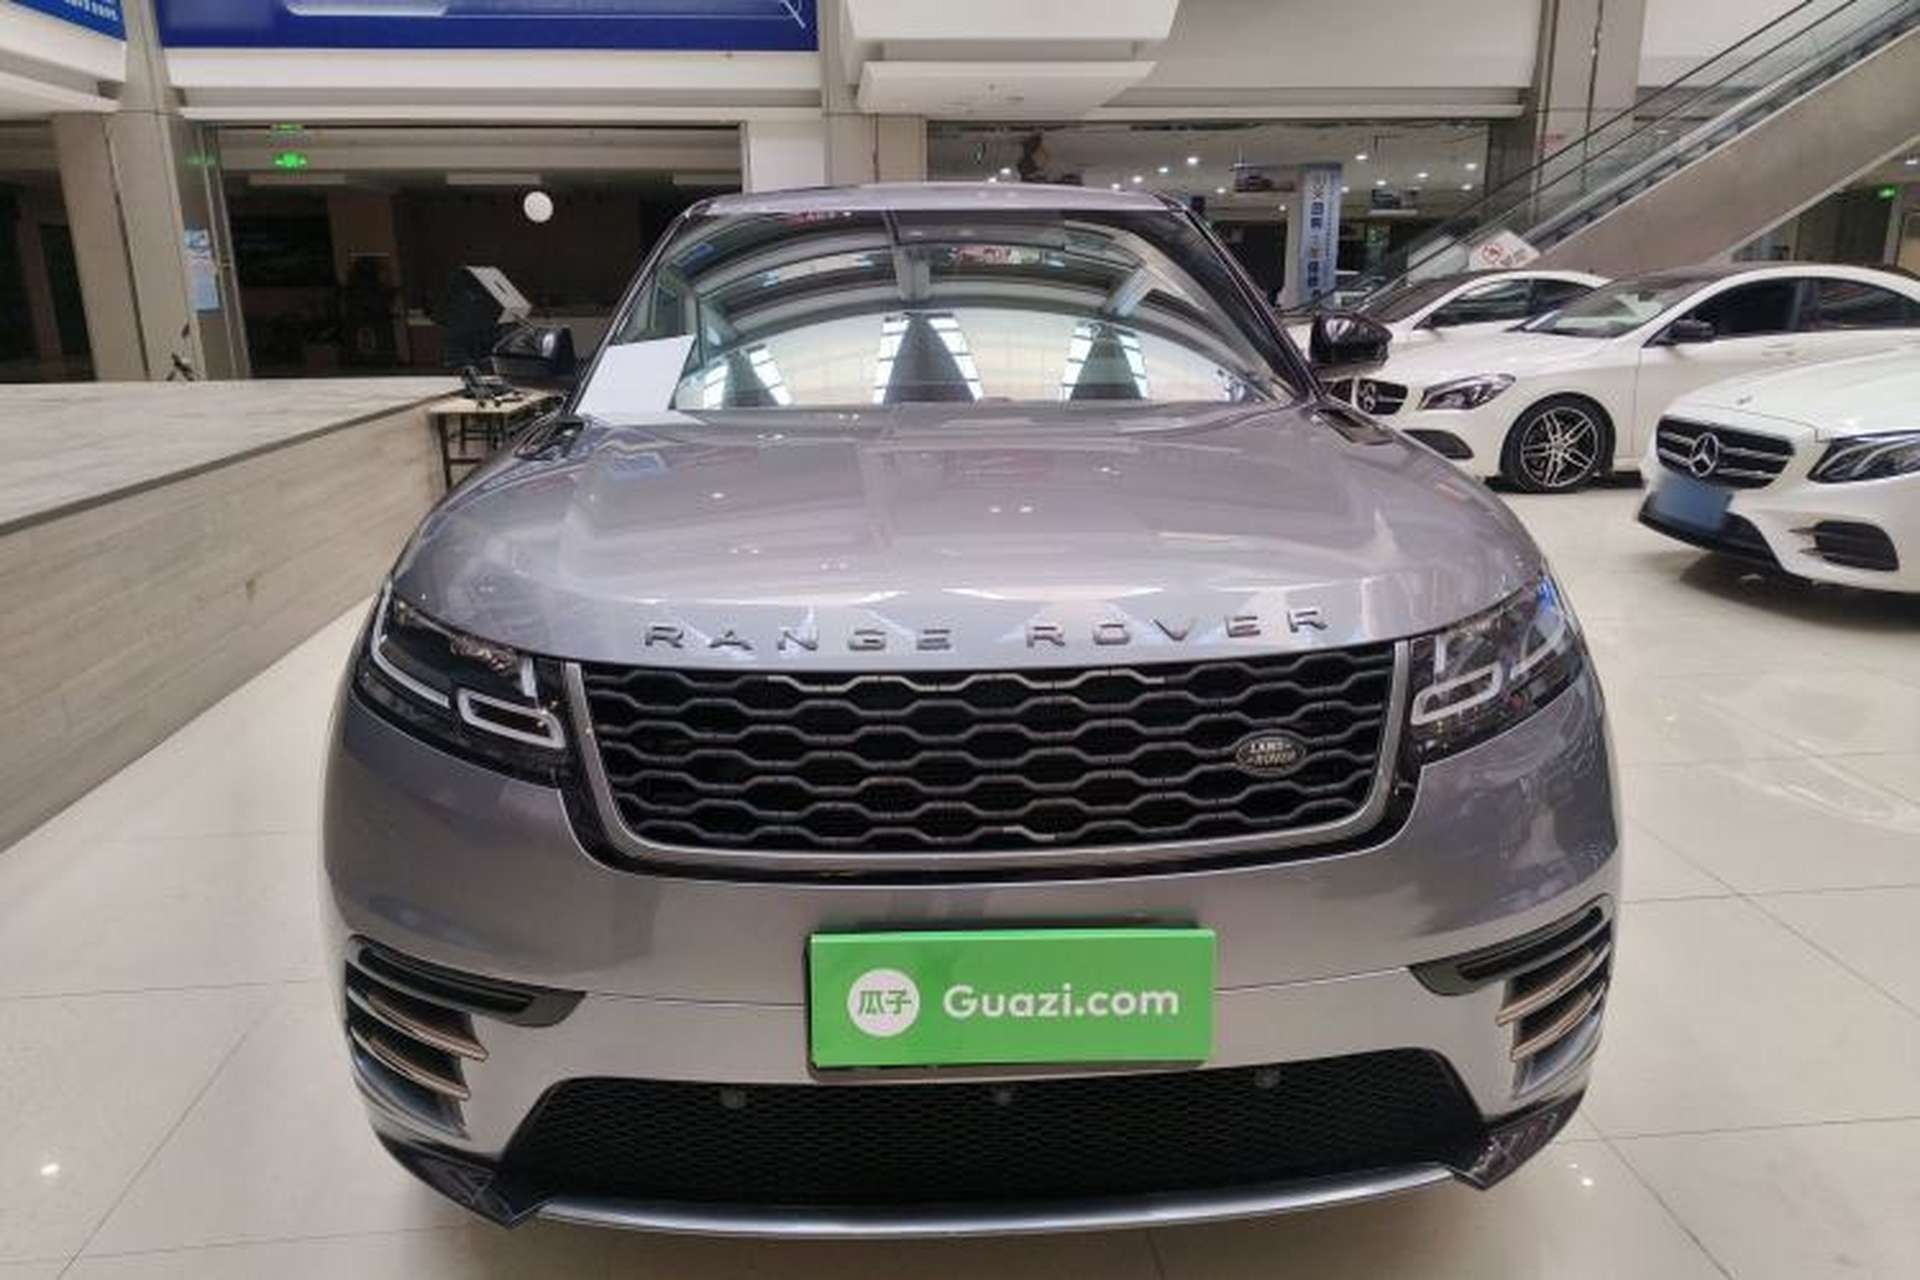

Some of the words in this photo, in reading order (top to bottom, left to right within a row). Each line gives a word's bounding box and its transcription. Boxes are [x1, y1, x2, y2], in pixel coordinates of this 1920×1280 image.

[645, 623, 951, 651] RANGE
[1026, 609, 1328, 648] ROVER
[857, 989, 912, 1016] 瓜子
[943, 983, 1179, 1018] Guazi.com
